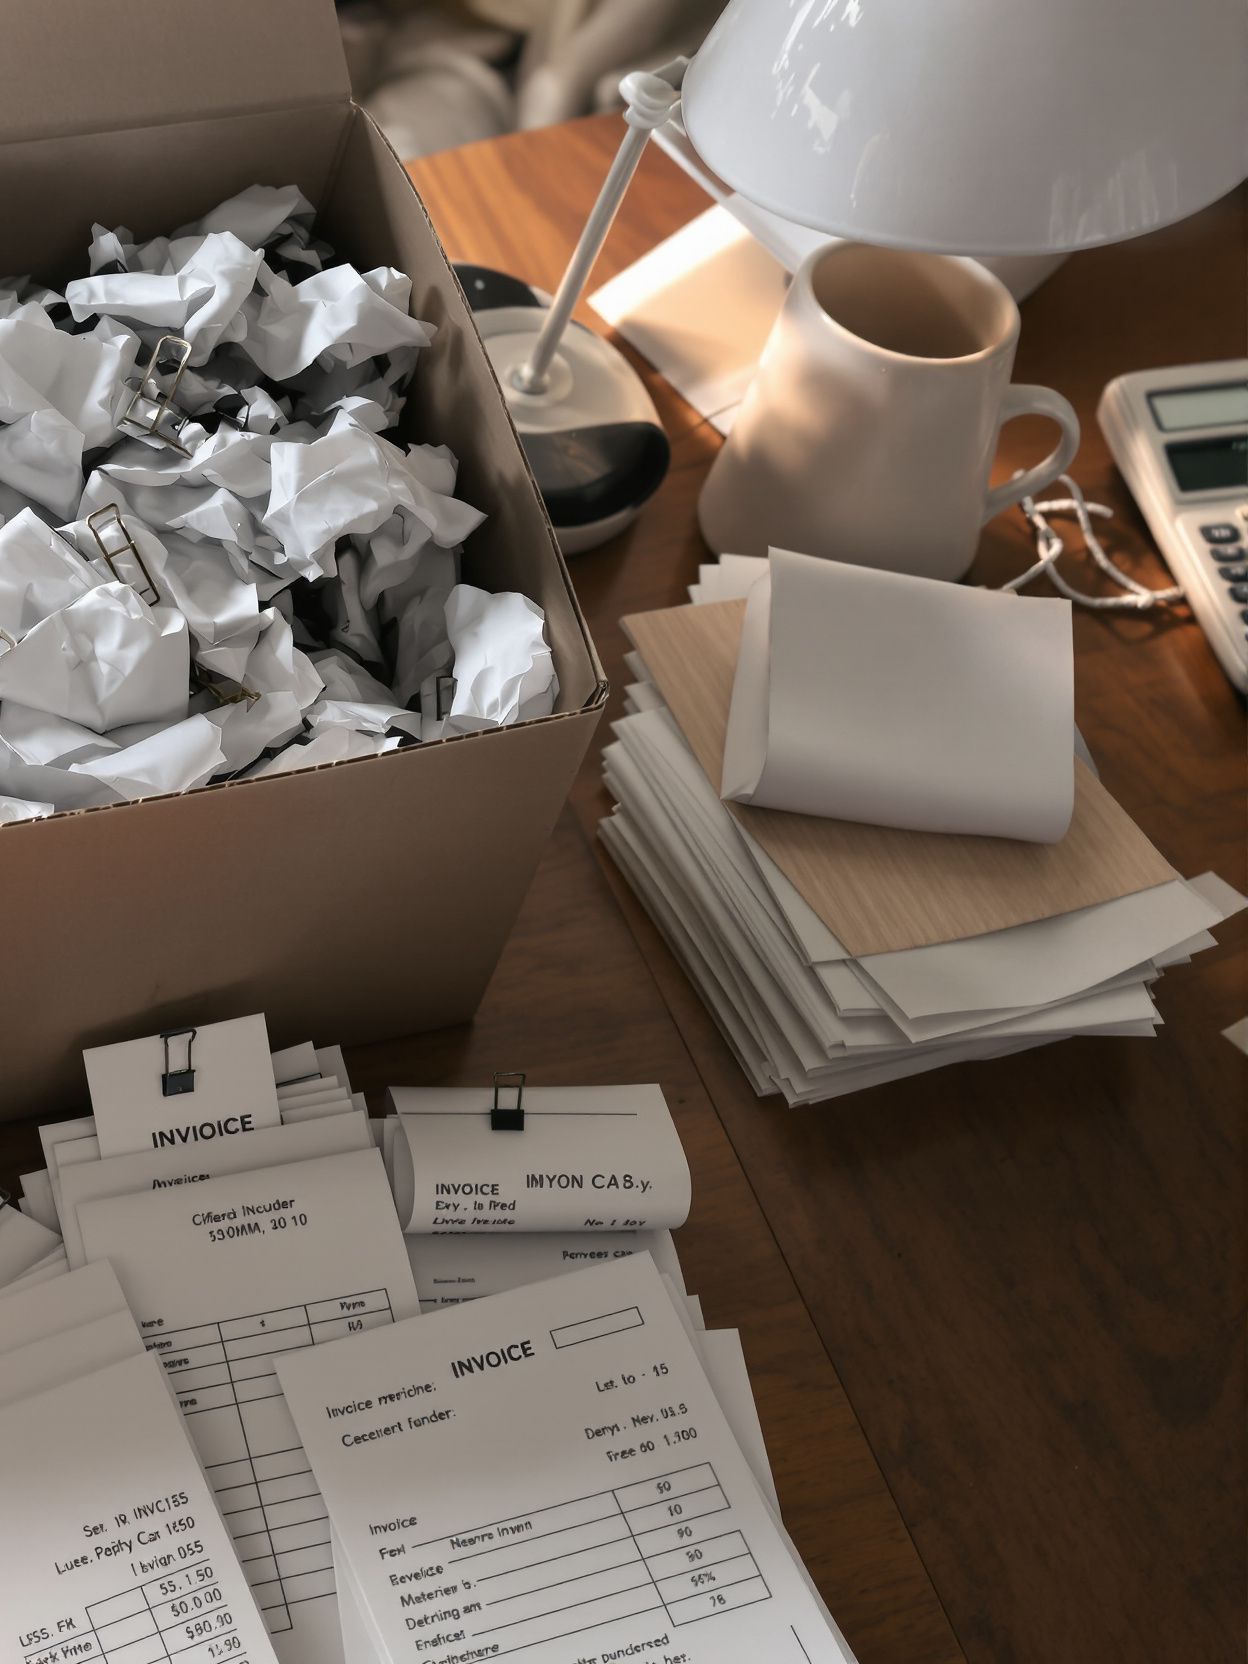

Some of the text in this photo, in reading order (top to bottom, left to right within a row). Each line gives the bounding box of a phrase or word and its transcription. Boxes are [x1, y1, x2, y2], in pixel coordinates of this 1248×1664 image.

[152, 1114, 255, 1148] INVIOICE
[435, 1183, 500, 1196] INVOICE
[450, 1339, 536, 1378] INVOICE
